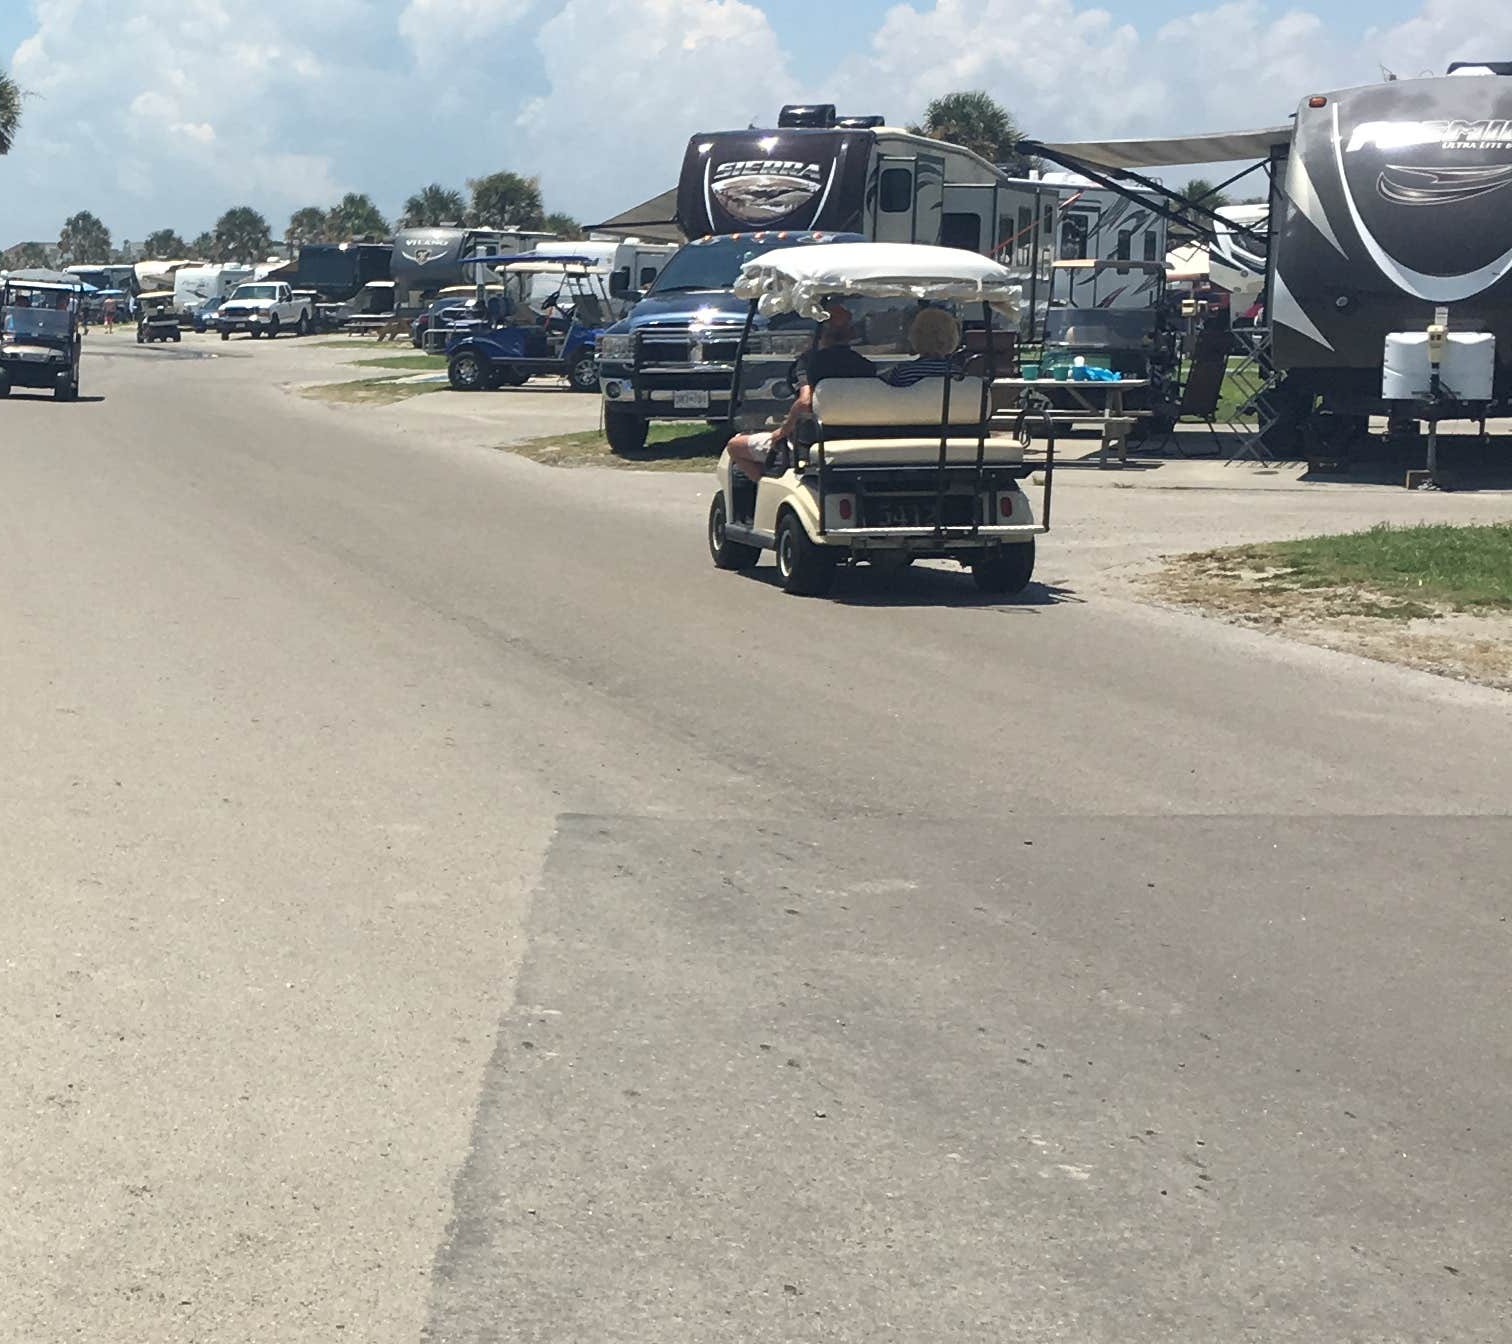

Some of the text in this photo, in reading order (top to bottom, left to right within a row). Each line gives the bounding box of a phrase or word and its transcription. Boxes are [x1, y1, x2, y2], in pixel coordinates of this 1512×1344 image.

[1441, 141, 1477, 149] ULTRA
[1479, 141, 1501, 149] LITE
[713, 160, 821, 180] SIERRA
